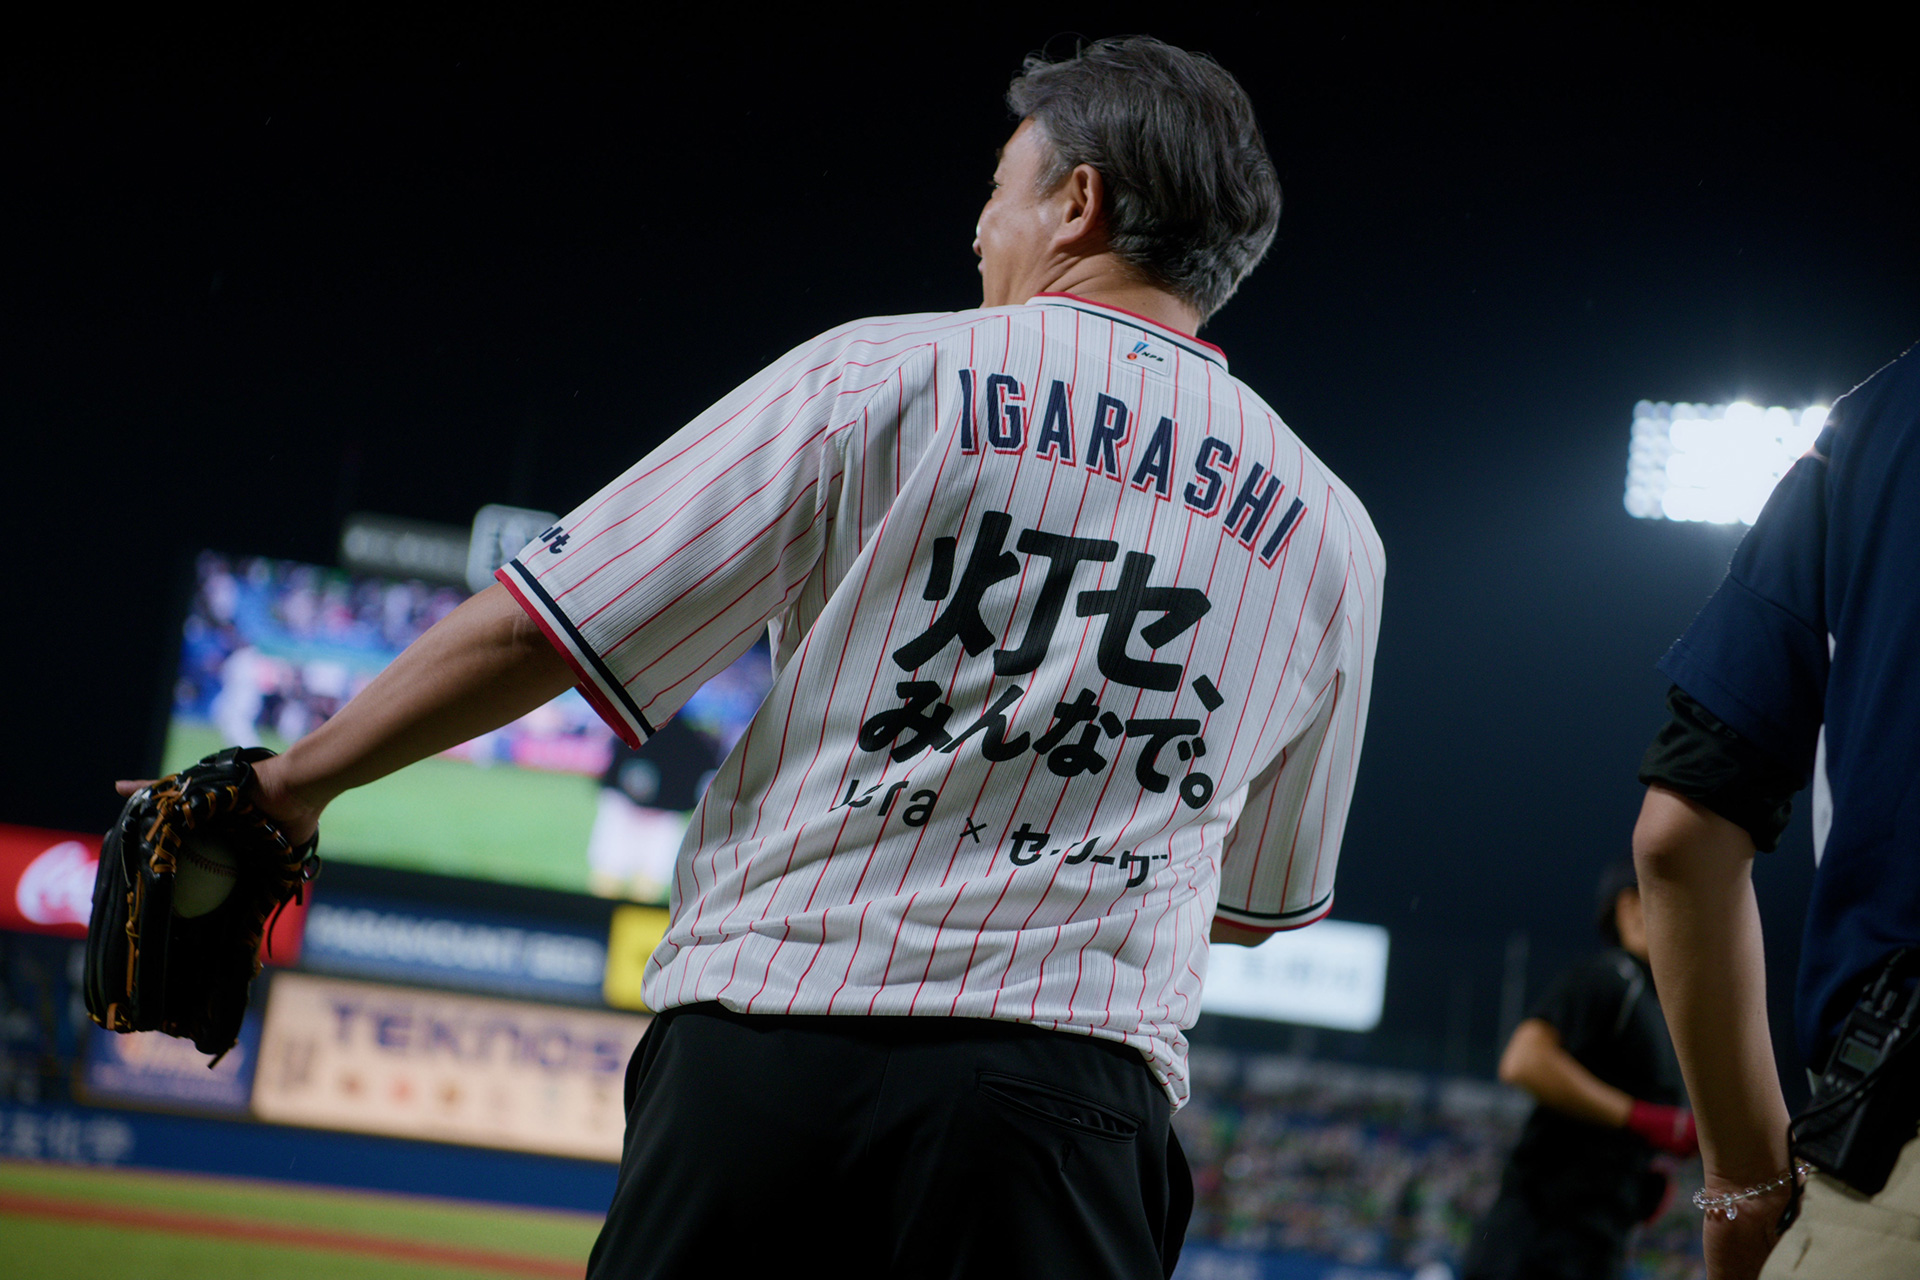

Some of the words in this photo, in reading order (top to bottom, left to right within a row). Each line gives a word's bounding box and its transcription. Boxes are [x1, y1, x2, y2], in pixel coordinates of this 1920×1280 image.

[538, 525, 571, 554] lt
[959, 368, 1307, 569] IGARASHI
[892, 510, 1224, 712] 灯セ、
[858, 680, 1214, 810] みんなで。
